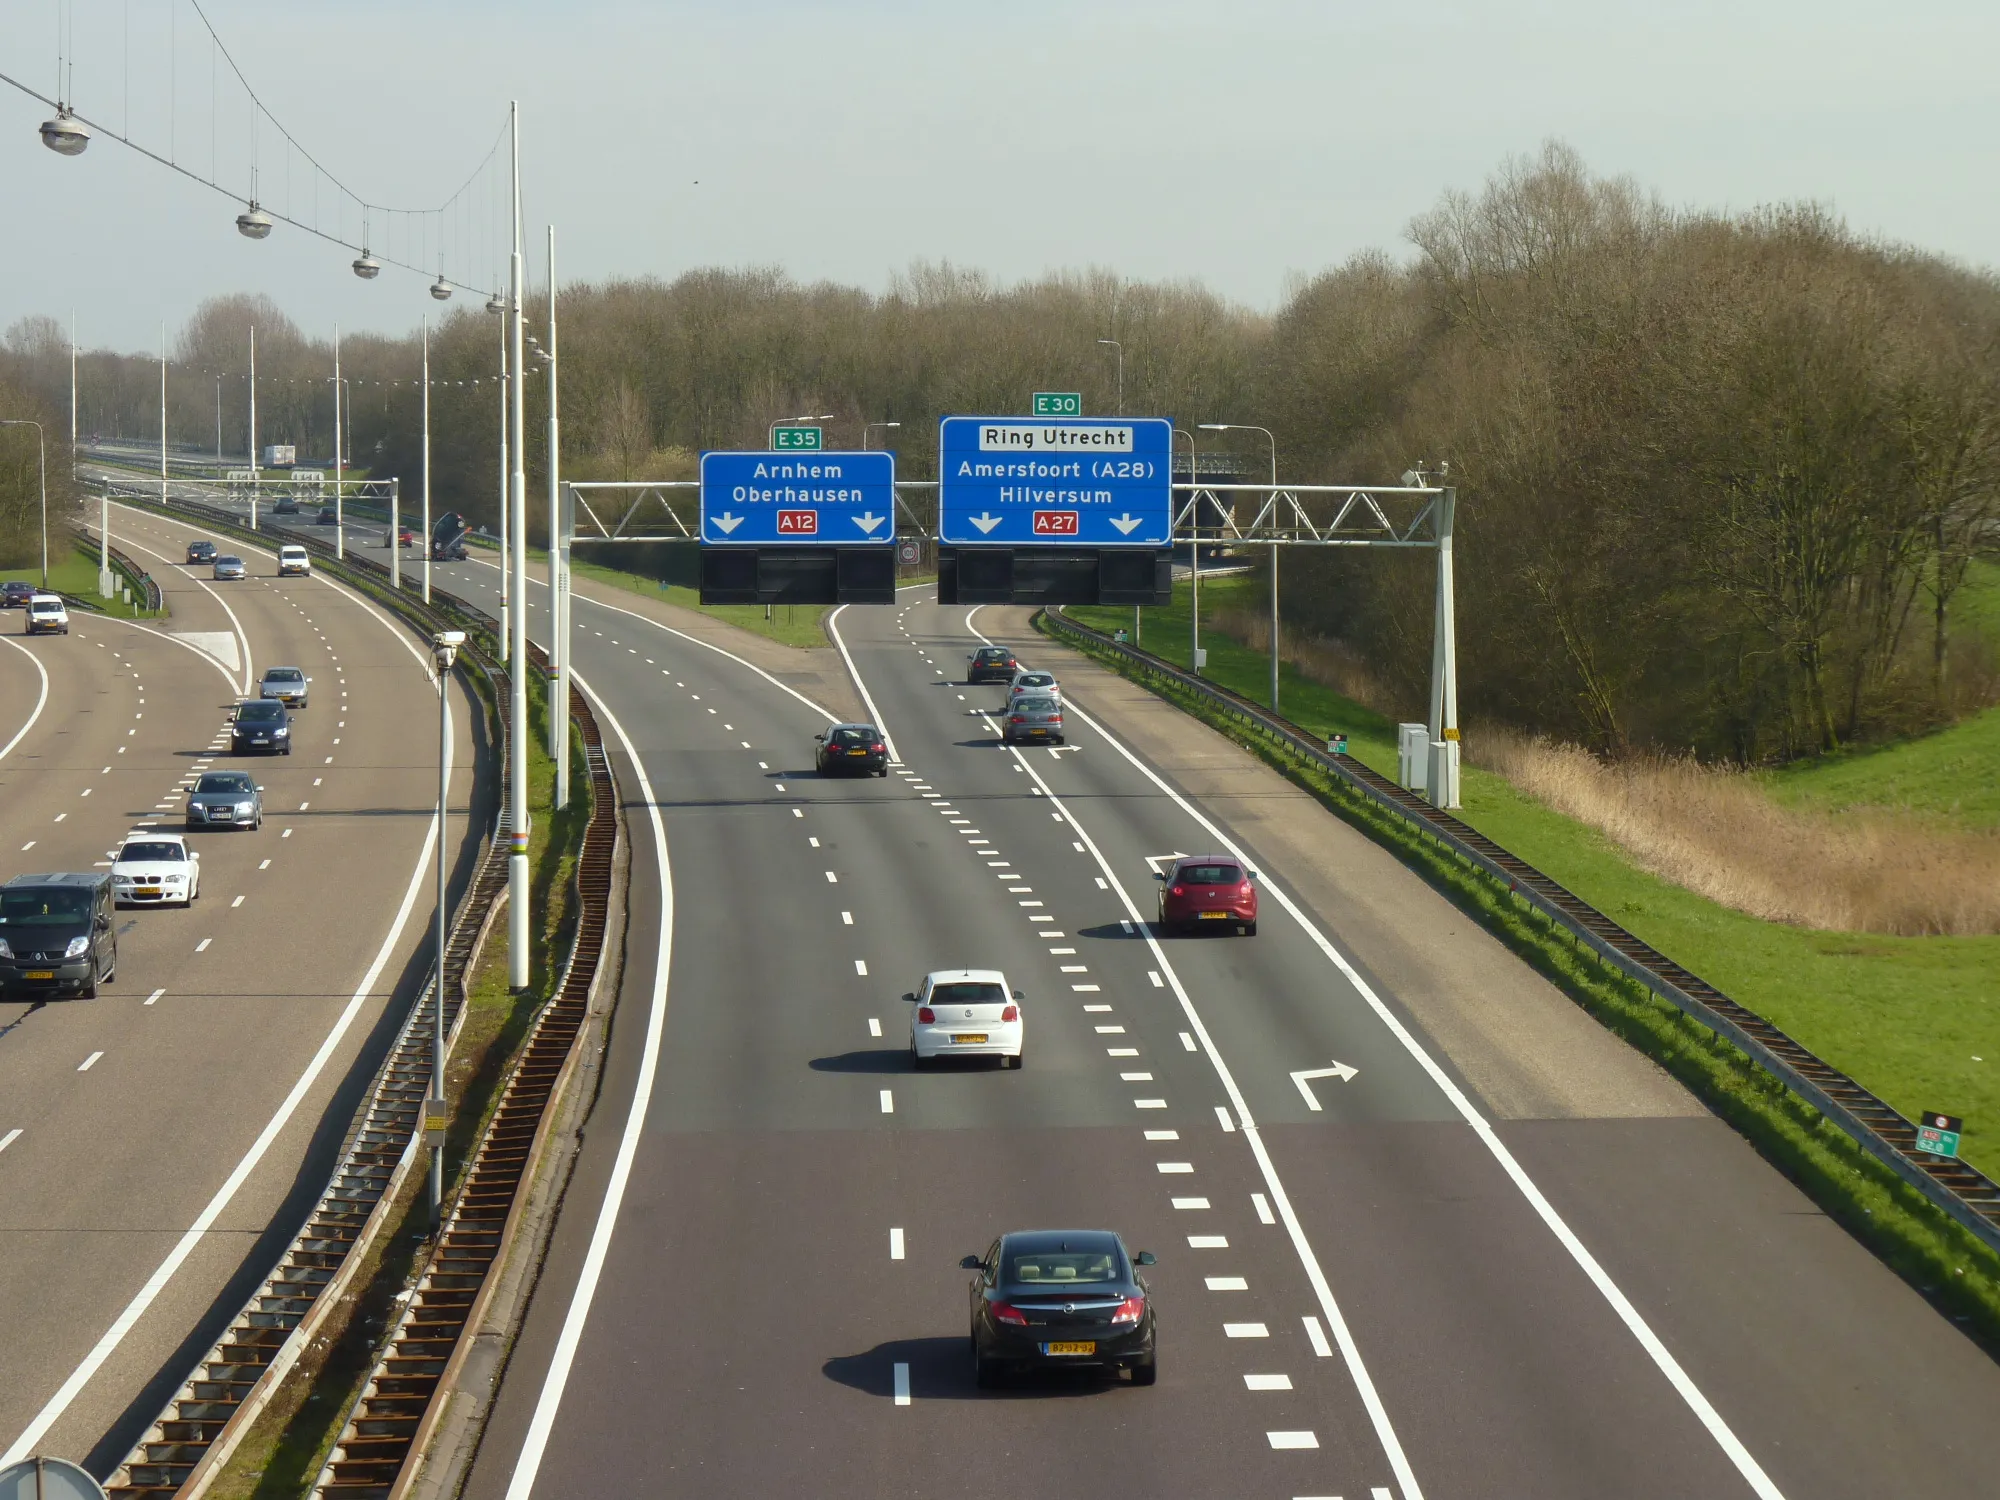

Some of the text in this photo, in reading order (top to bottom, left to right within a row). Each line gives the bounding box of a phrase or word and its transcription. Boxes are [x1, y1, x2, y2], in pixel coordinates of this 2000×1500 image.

[985, 428, 1127, 449] Ring Utrecht
[753, 462, 842, 478] Arnhem
[958, 460, 1154, 479] Amersfoort (A28)
[732, 485, 862, 502] Oberhausen
[999, 486, 1112, 504] Hilversum
